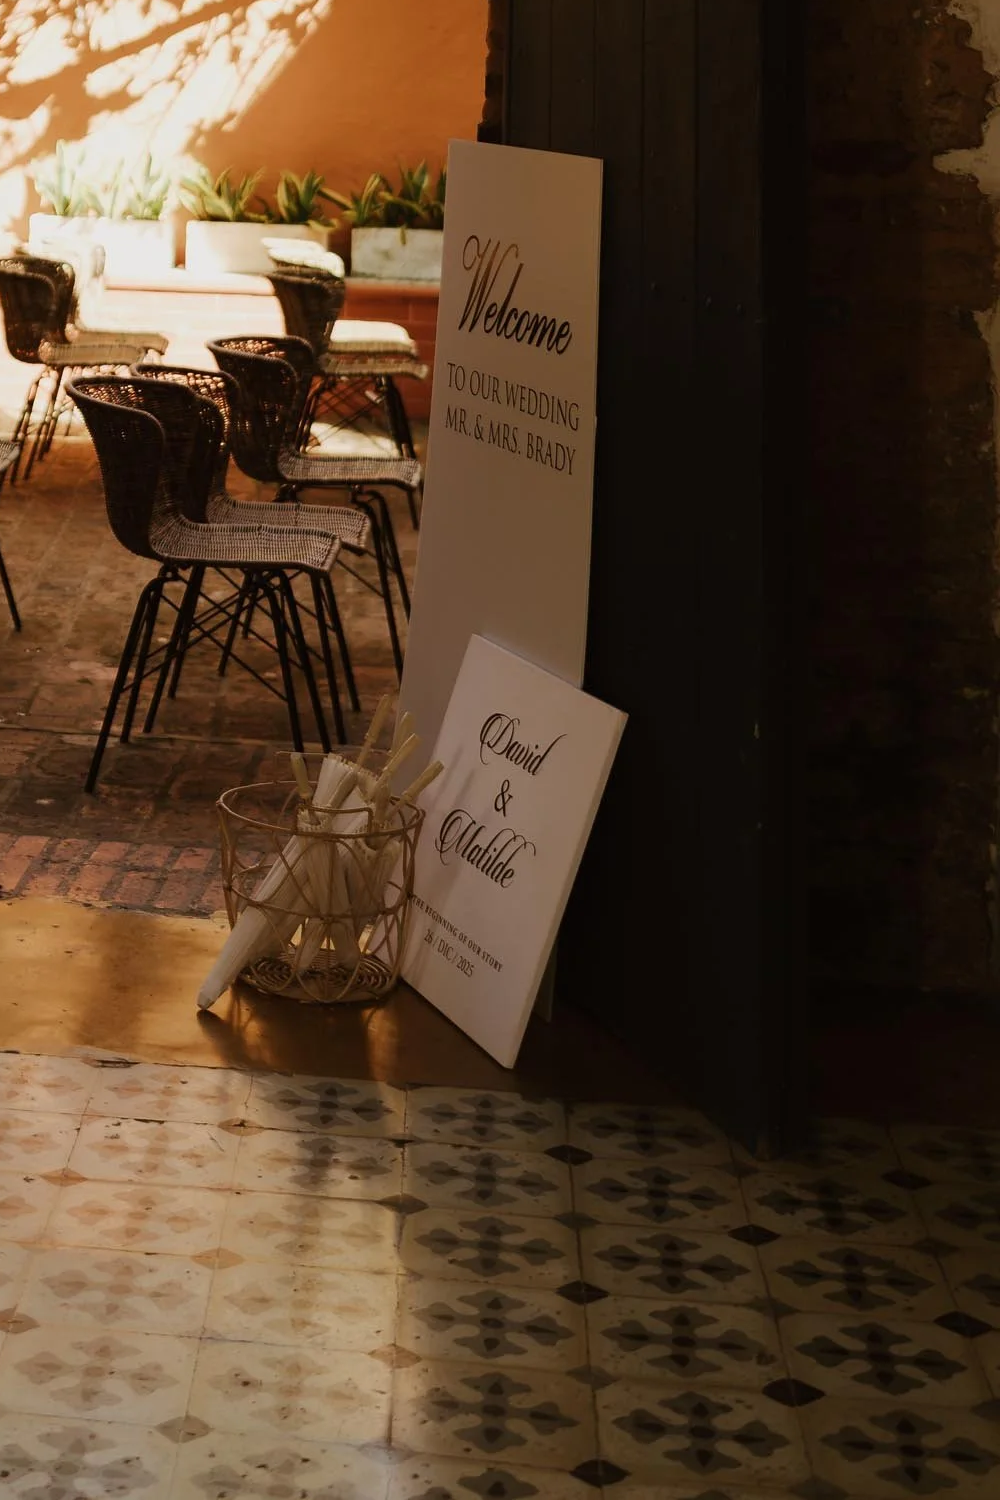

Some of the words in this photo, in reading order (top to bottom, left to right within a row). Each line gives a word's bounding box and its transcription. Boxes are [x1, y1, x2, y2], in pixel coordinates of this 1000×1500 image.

[458, 235, 573, 354] Welcome
[447, 362, 466, 391] TO
[469, 370, 502, 405] OUR
[505, 380, 580, 431] WEDDING
[445, 404, 471, 437] MR.
[474, 414, 484, 442] &
[488, 420, 521, 455] MRS.
[526, 432, 576, 475] BRADY
[480, 712, 568, 776] David
[494, 779, 514, 817] &
[434, 809, 537, 889] Matilde
[424, 905, 459, 937] BEGINNING
[458, 931, 468, 944] OF
[467, 939, 482, 956] OUR
[481, 950, 503, 972] STORY
